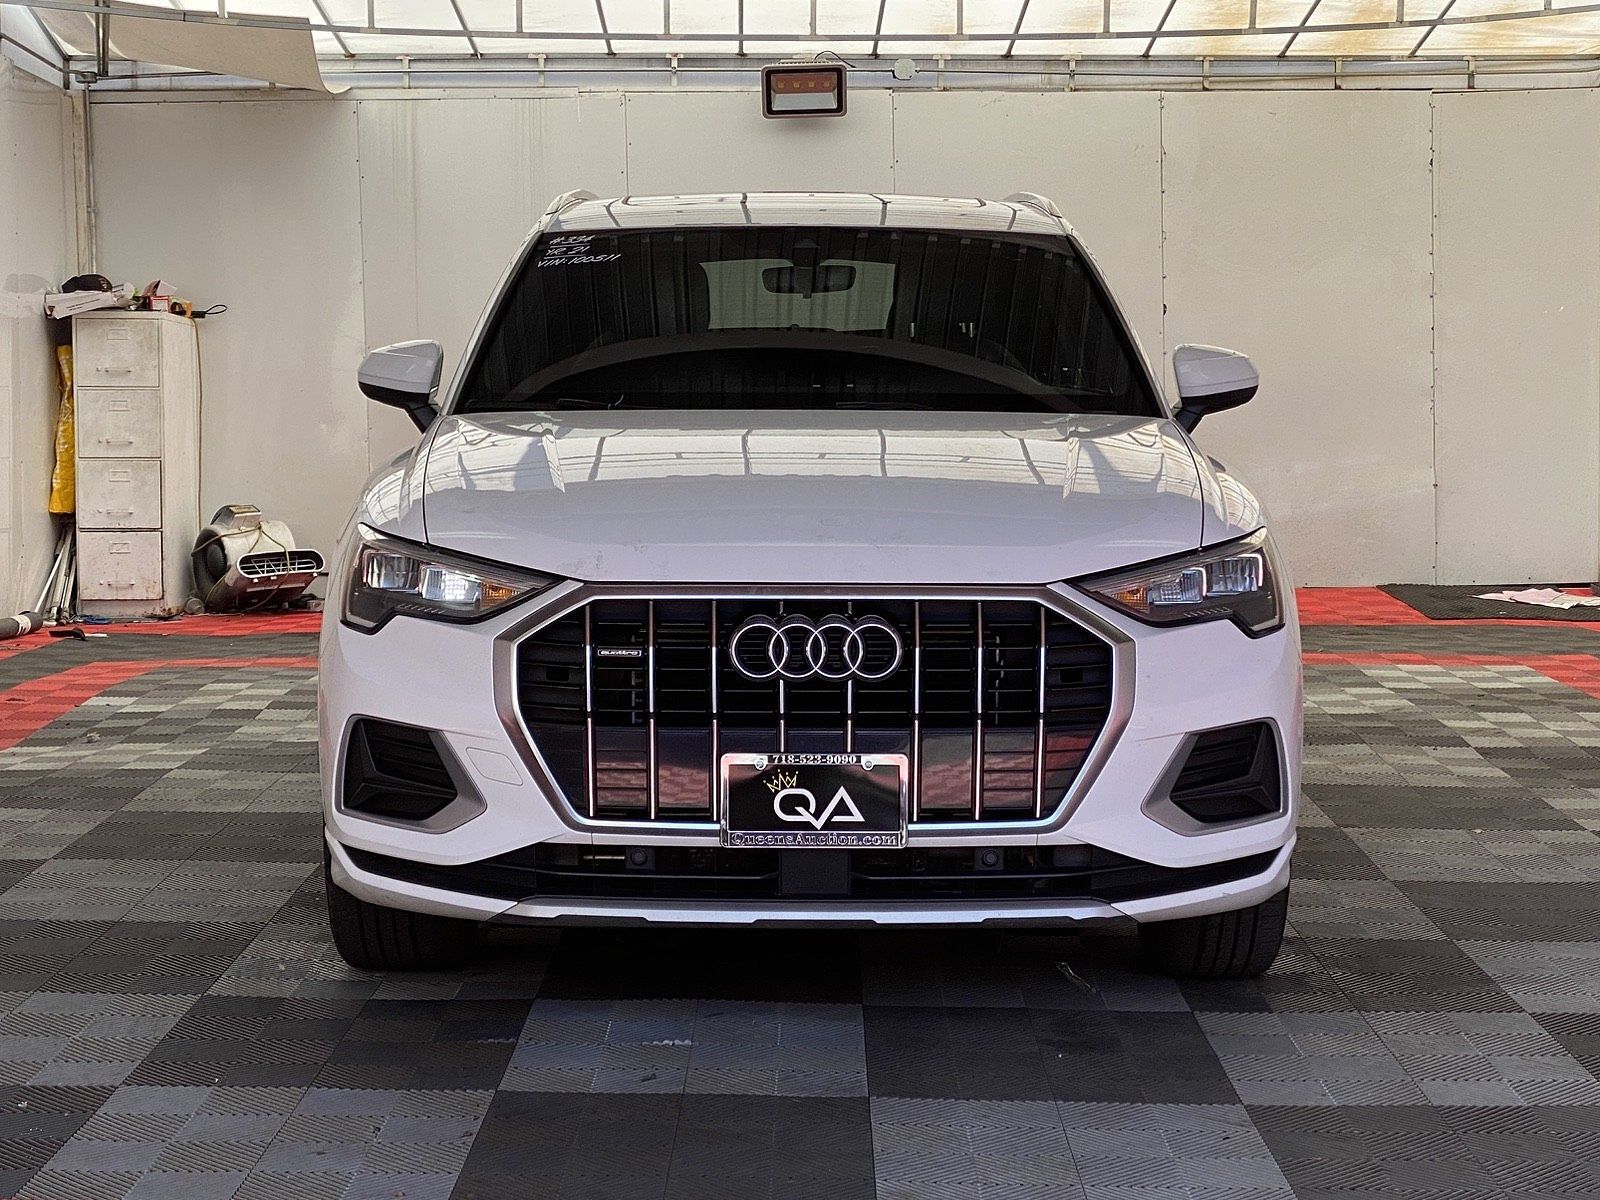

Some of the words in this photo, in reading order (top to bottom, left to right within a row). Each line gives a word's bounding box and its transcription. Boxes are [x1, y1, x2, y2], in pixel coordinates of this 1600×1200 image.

[567, 245, 591, 255] 21
[772, 754, 857, 765] 718-523-9090
[773, 786, 866, 831] QA
[731, 832, 897, 846] QueensAuction.com
